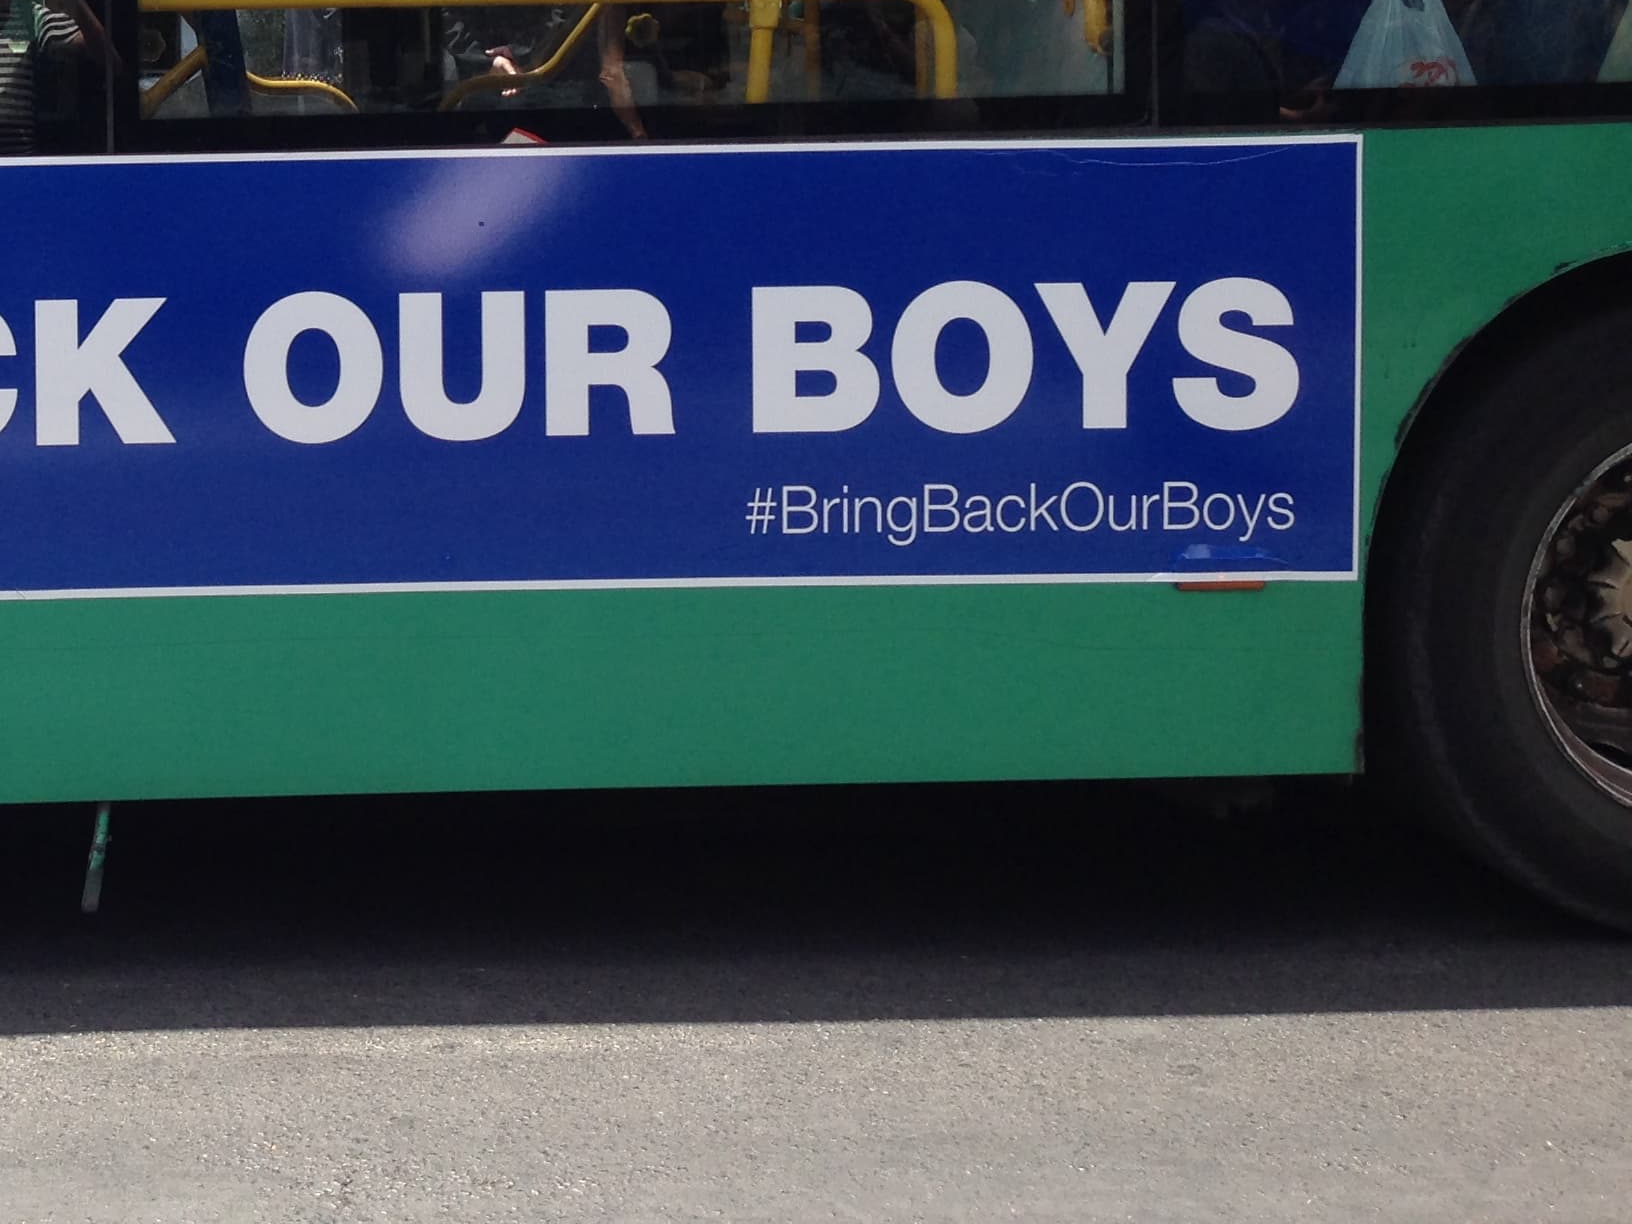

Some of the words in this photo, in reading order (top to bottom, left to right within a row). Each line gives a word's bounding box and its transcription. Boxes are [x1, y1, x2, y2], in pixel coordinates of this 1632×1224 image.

[244, 289, 675, 443] OUR
[752, 278, 1299, 433] BOYS
[746, 482, 1294, 545] #BringBackOurBoys
